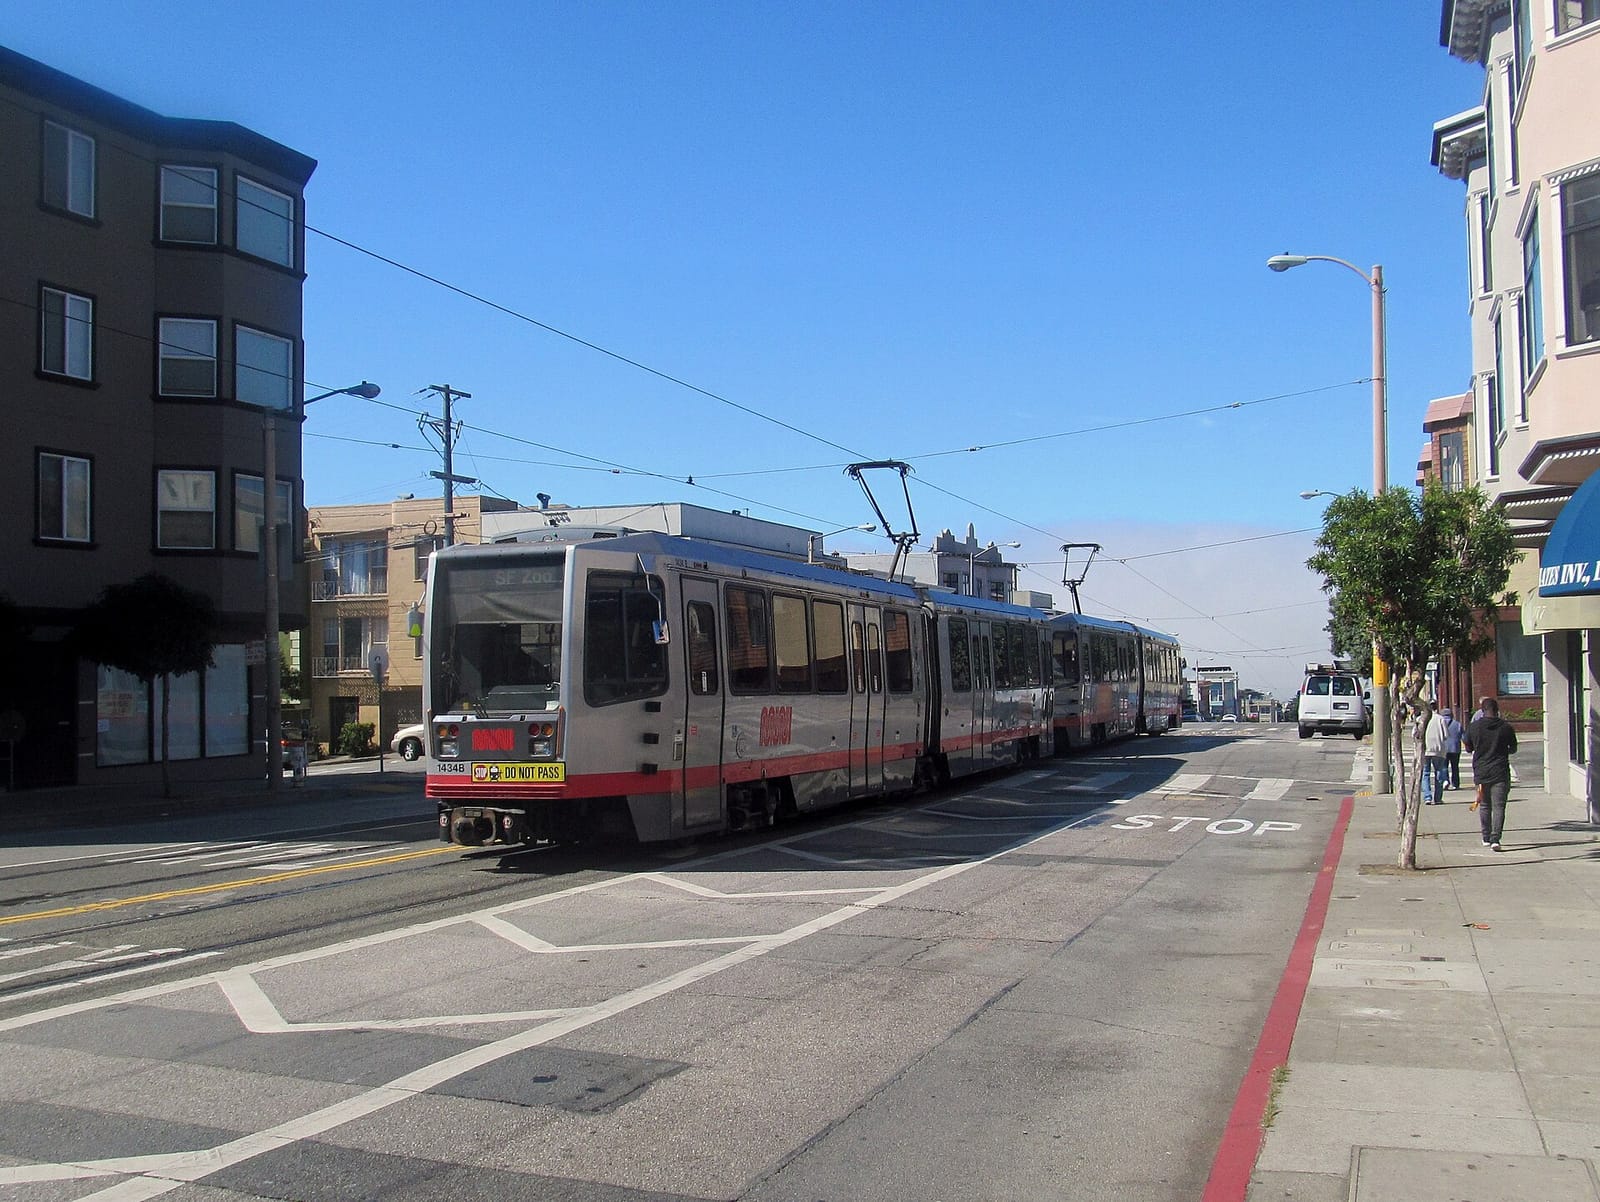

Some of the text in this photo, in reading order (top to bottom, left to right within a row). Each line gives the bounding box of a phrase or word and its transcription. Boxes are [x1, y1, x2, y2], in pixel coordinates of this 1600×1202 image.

[437, 763, 465, 773] 1434B
[475, 767, 487, 778] STOP
[505, 766, 560, 778] DO NOT PASS
[1111, 814, 1302, 836] STOP
